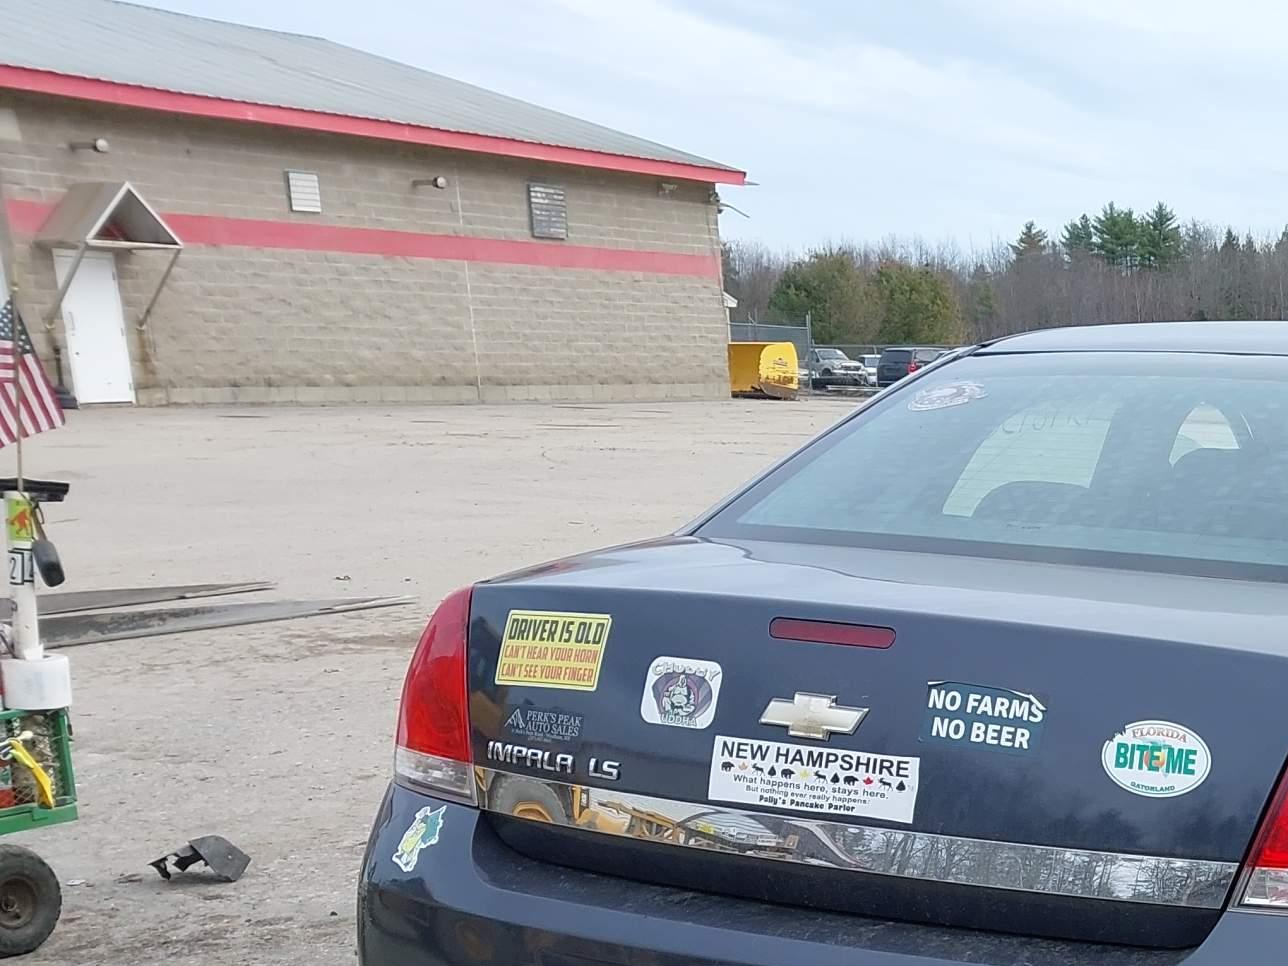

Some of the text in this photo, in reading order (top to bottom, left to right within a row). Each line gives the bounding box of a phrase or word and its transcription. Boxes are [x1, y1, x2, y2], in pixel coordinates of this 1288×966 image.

[508, 618, 605, 645] DRIVER IS OLD
[504, 645, 599, 664] CAN'T HEAR YOUR HORN
[501, 663, 594, 682] CAN'T SEE YOUR FINGER
[928, 689, 1043, 723] NO FARMS
[527, 710, 583, 727] PERK'S PEAK
[526, 720, 551, 733] AUTO
[551, 723, 579, 737] SALES
[931, 716, 1030, 749] NO BEER
[1132, 726, 1187, 743] FLORIDA
[487, 741, 621, 780] IMPALA LS
[721, 740, 910, 778] NEW HAMPSHIRE
[1114, 742, 1197, 775] BITE ME
[733, 773, 889, 799] What happens here, stays here.
[745, 785, 759, 793] But
[760, 787, 788, 798] nothing
[790, 791, 808, 799] ever
[808, 793, 830, 802] really
[1130, 781, 1176, 792] GATORLAND
[759, 795, 855, 812] Polly's Pancake Parlor
